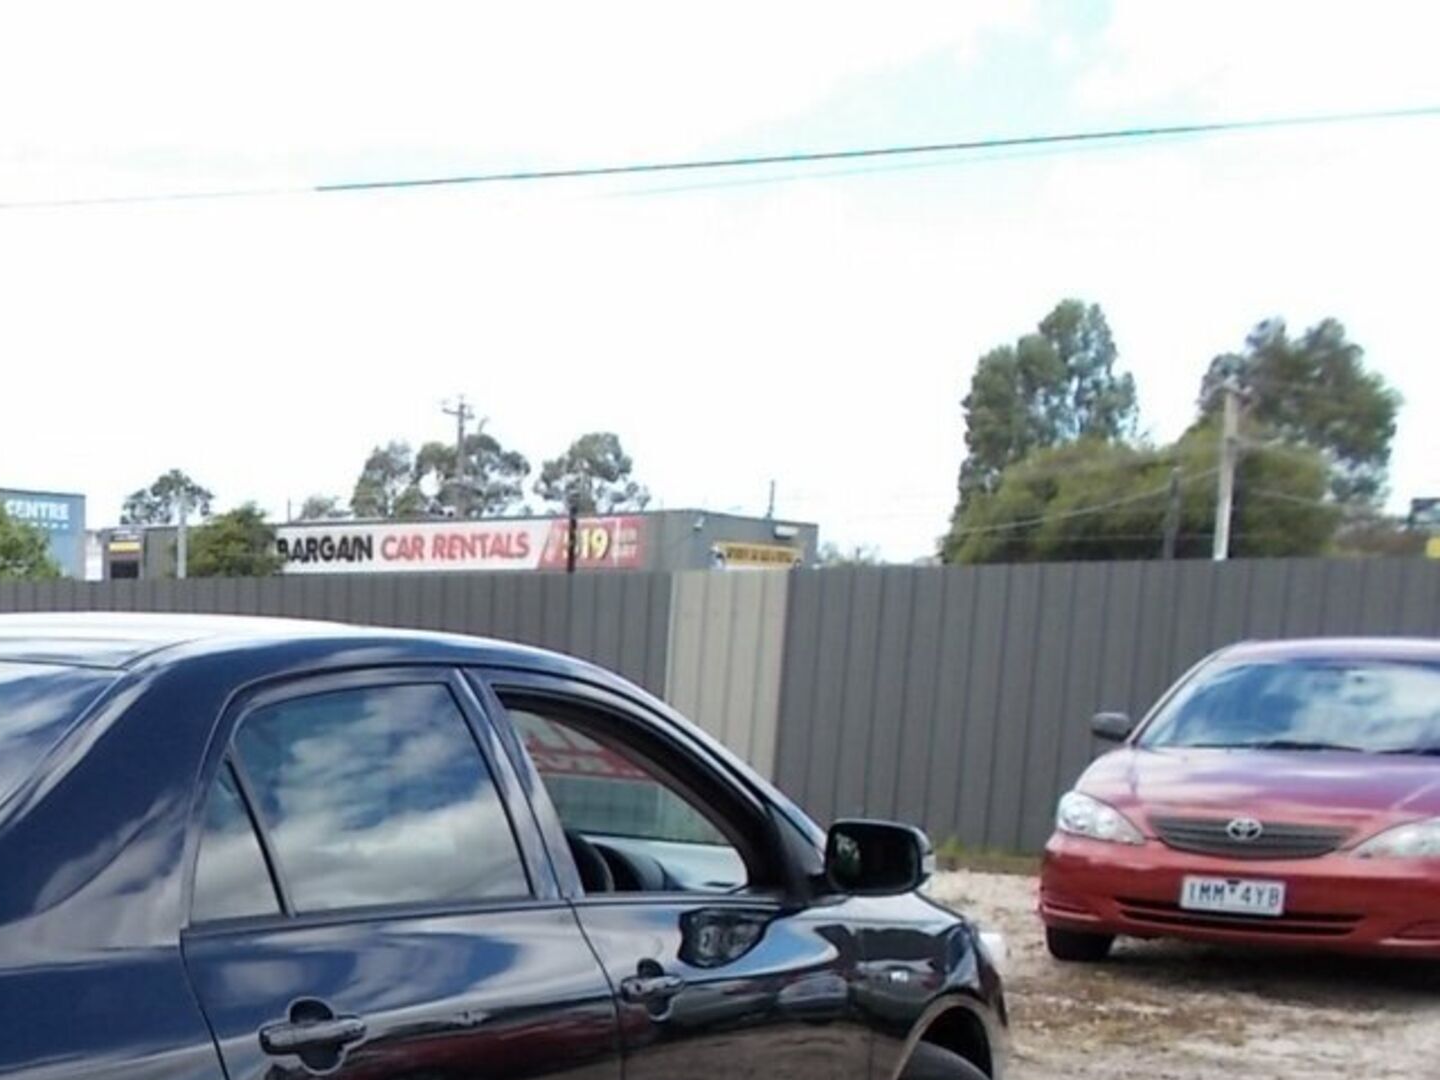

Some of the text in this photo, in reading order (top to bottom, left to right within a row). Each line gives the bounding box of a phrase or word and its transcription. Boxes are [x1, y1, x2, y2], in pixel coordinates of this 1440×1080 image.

[5, 500, 70, 520] CENTRE
[276, 534, 373, 563] BARGAIN
[380, 536, 424, 560] CAR
[432, 532, 529, 560] RENTALS
